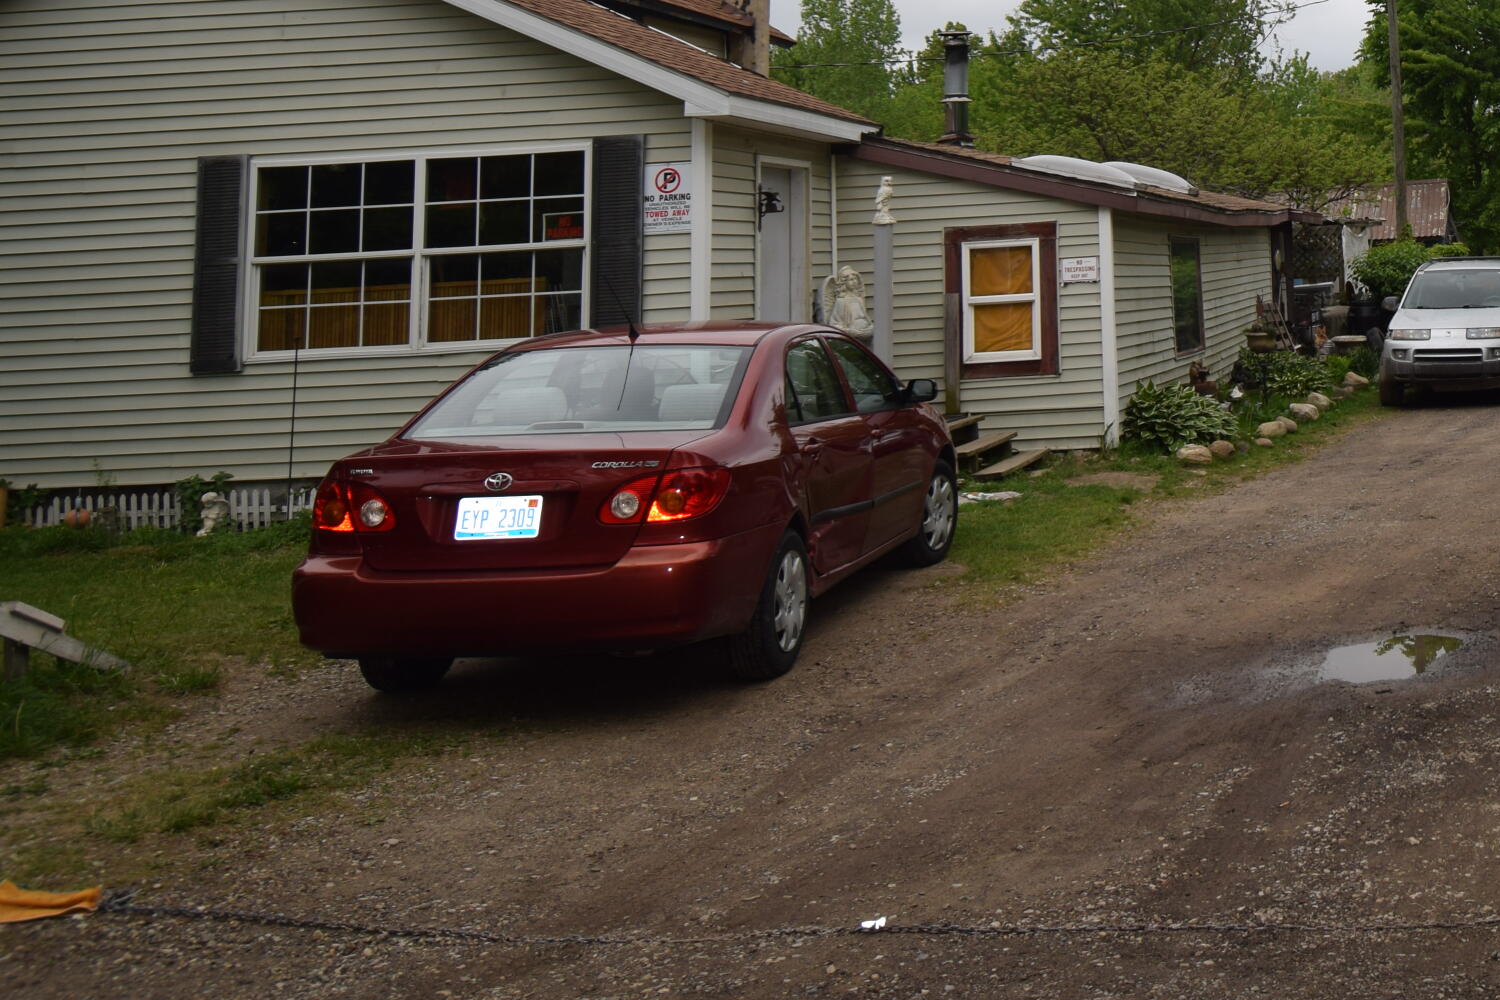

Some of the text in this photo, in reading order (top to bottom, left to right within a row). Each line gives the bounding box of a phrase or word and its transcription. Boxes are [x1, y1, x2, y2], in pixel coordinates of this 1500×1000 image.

[659, 193, 690, 201] PARKING
[461, 508, 535, 529] EYP 2309
